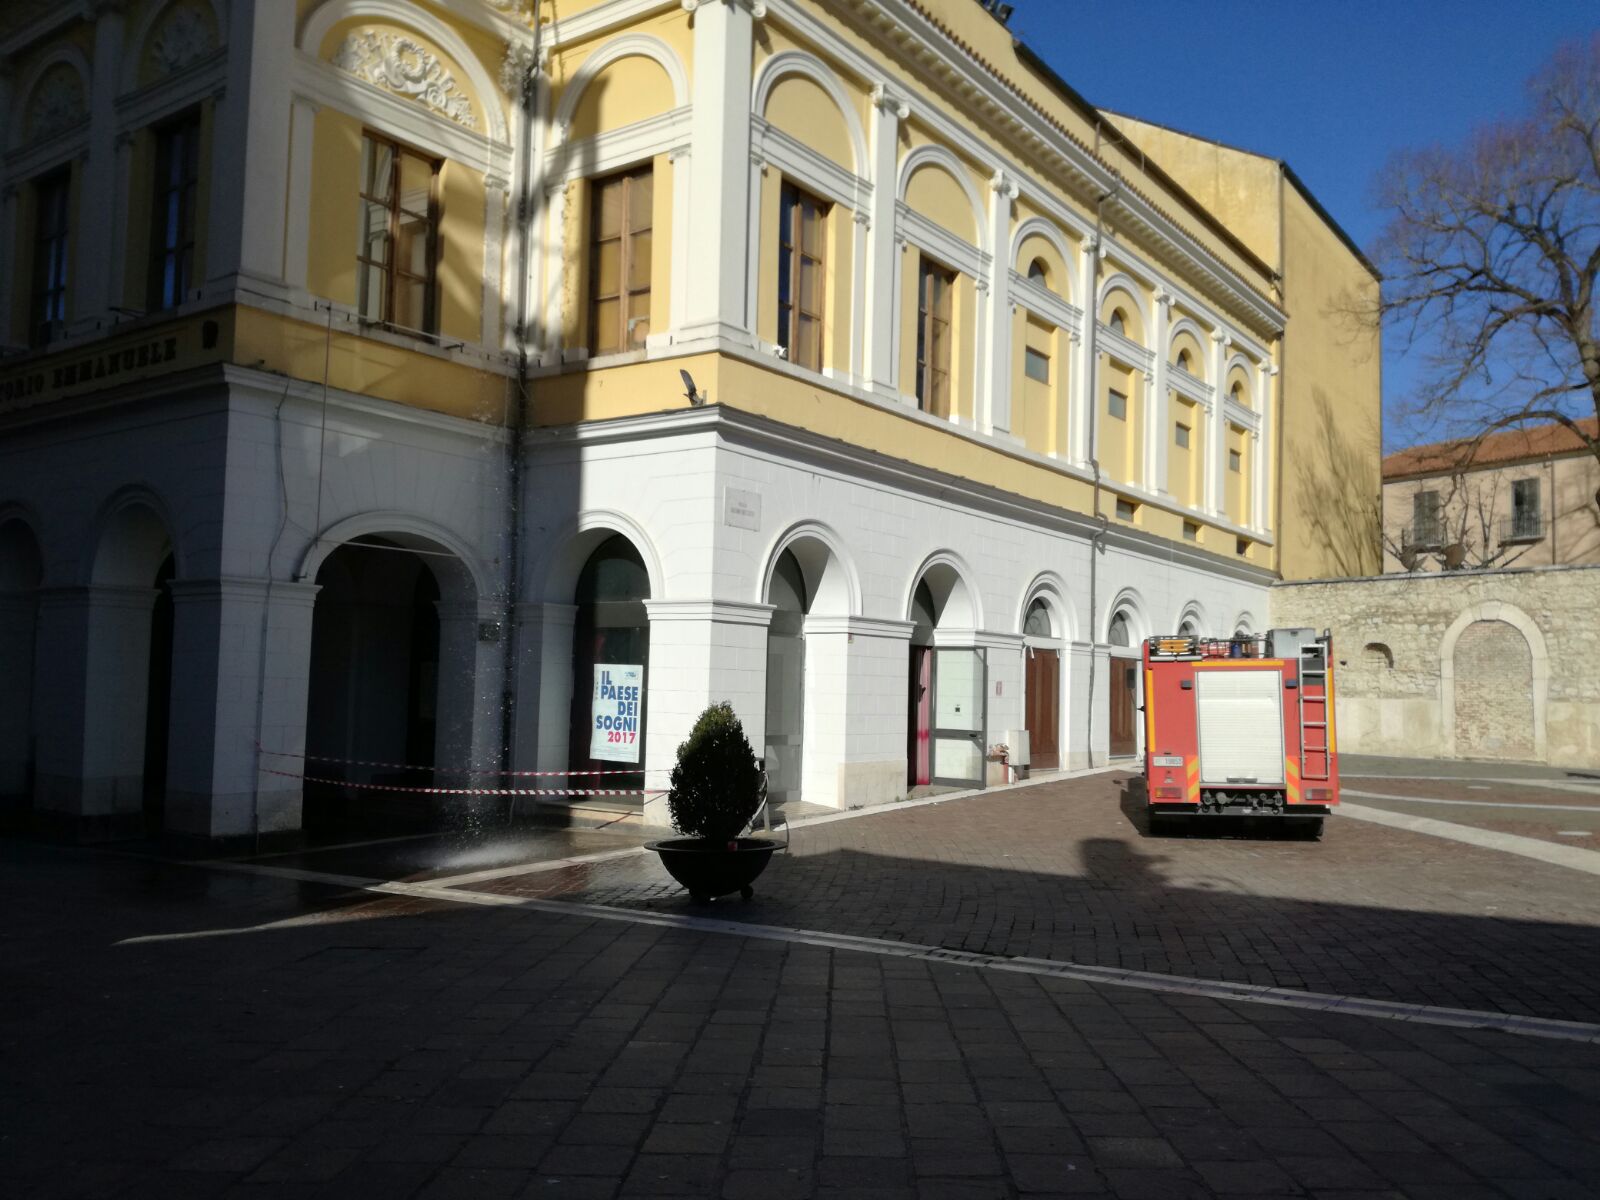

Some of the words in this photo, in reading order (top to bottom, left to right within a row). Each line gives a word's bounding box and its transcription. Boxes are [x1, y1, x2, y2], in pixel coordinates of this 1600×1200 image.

[52, 338, 177, 389] EMMANUELE
[602, 671, 612, 685] IL
[601, 686, 638, 701] PAESE
[617, 701, 637, 716] DEI
[596, 715, 637, 732] SOGNI
[607, 731, 636, 744] 2017
